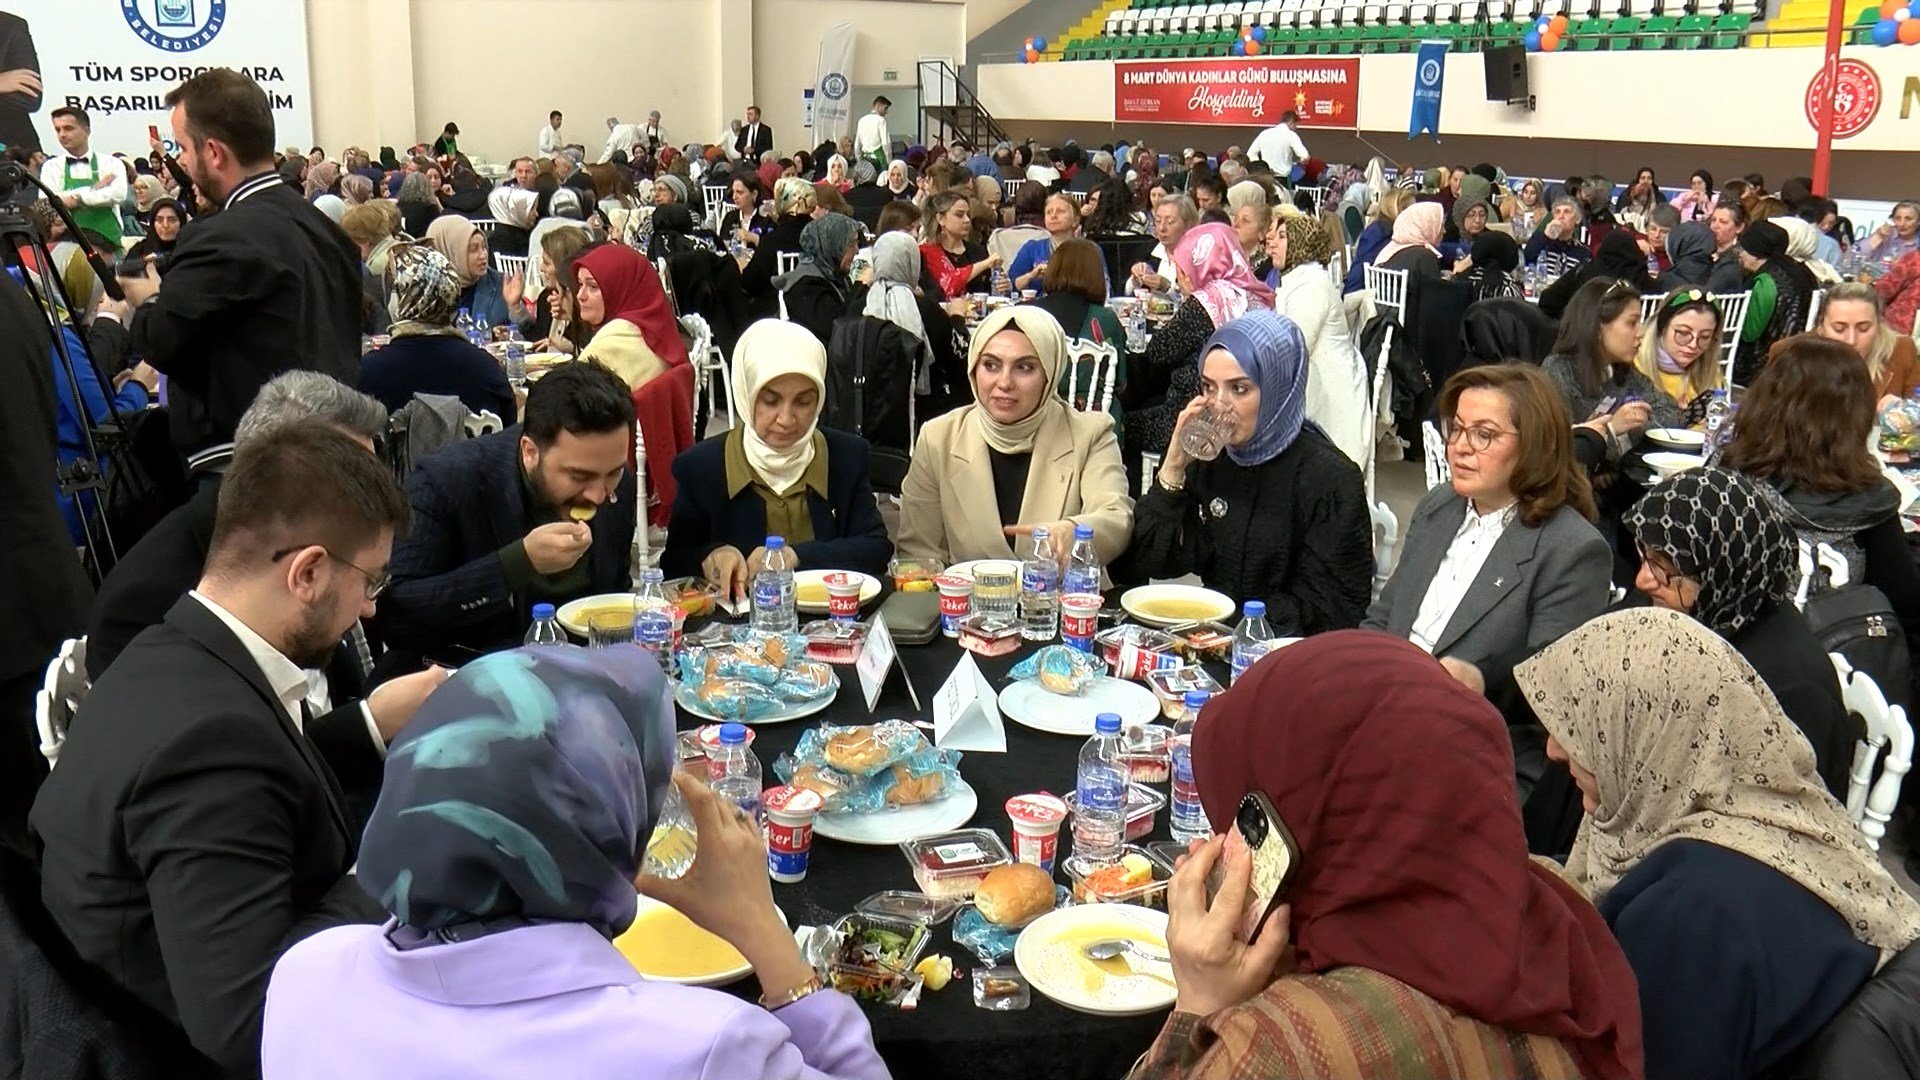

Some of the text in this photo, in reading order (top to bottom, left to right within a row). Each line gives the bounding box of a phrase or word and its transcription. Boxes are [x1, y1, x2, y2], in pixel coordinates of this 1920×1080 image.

[69, 62, 284, 82] TÜM SPORCARA
[1123, 67, 1347, 87] 8 MART DÜNYA KADINLAR GÜNÜ BULUŞMASINA
[65, 95, 166, 116] BAŞARIL
